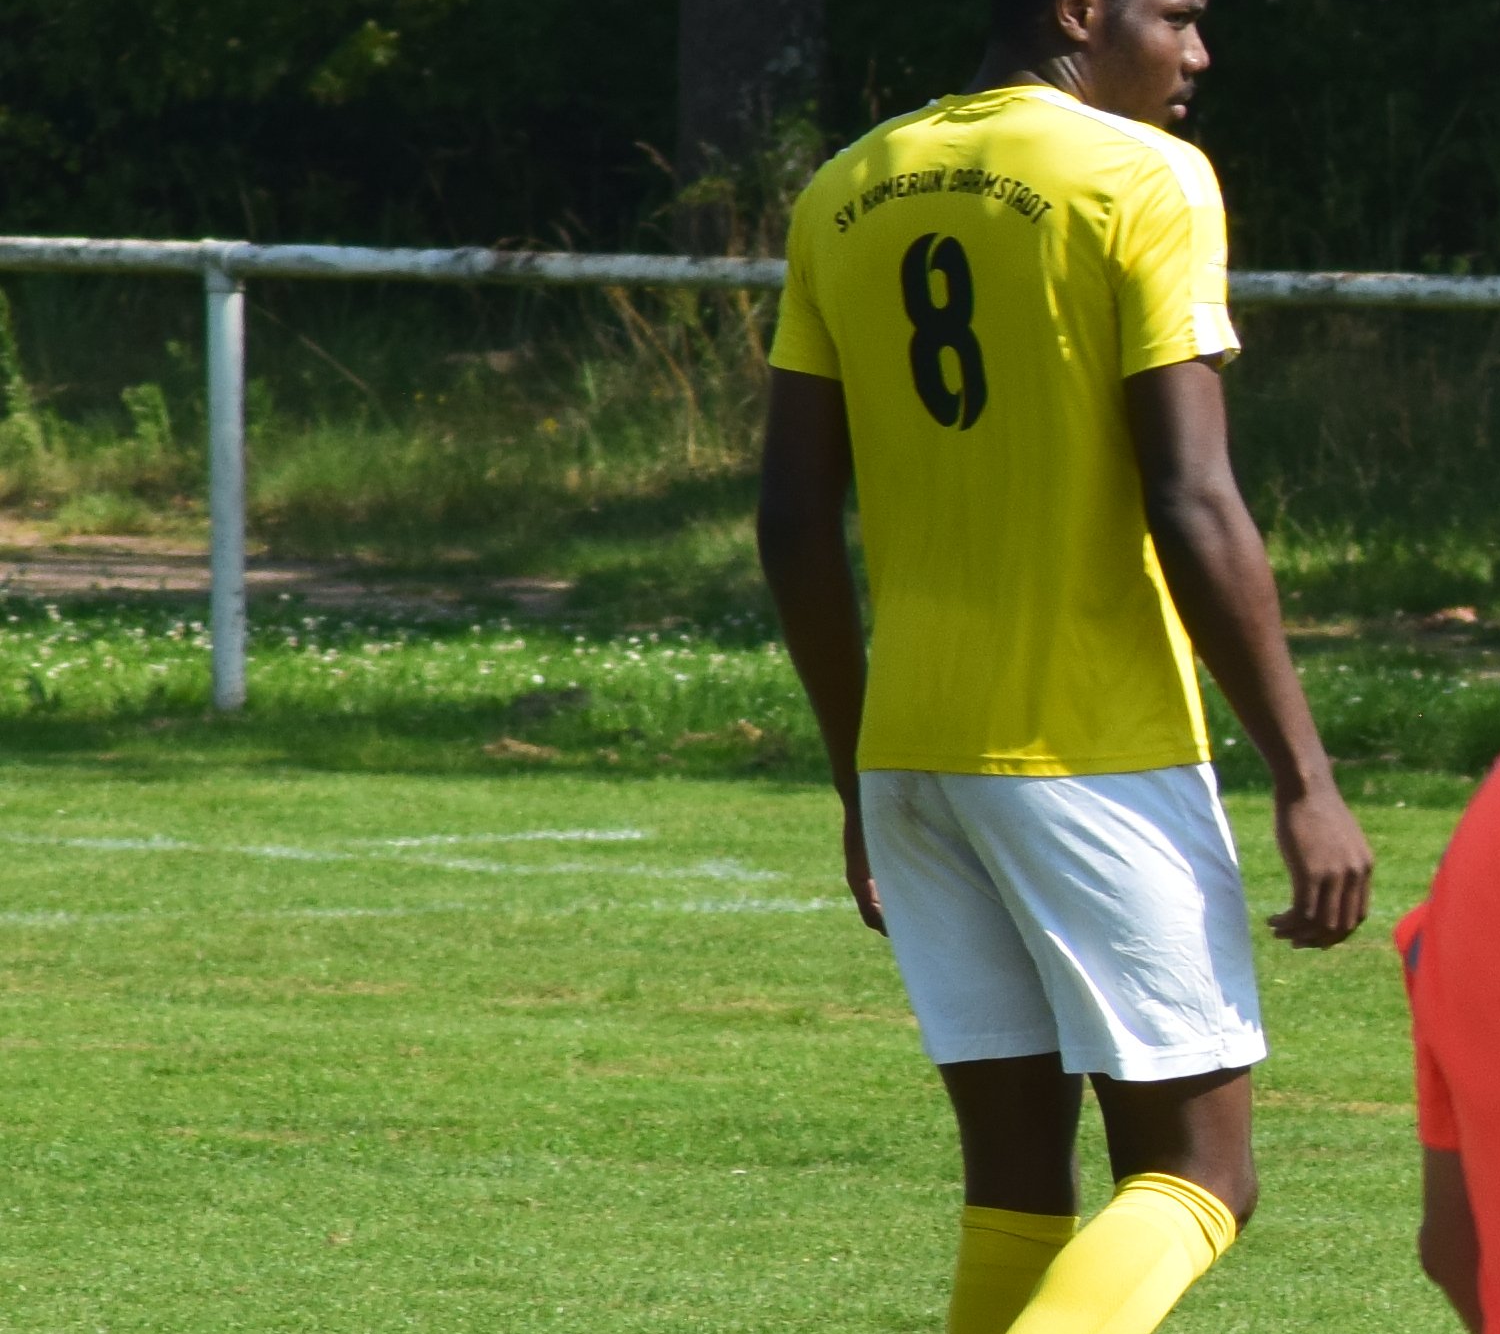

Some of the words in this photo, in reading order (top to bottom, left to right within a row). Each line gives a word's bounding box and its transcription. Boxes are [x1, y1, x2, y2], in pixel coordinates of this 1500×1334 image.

[834, 199, 857, 234] SV
[860, 165, 946, 216] KAMERUN
[948, 167, 1053, 224] DARMSTADT
[901, 232, 988, 432] 8
